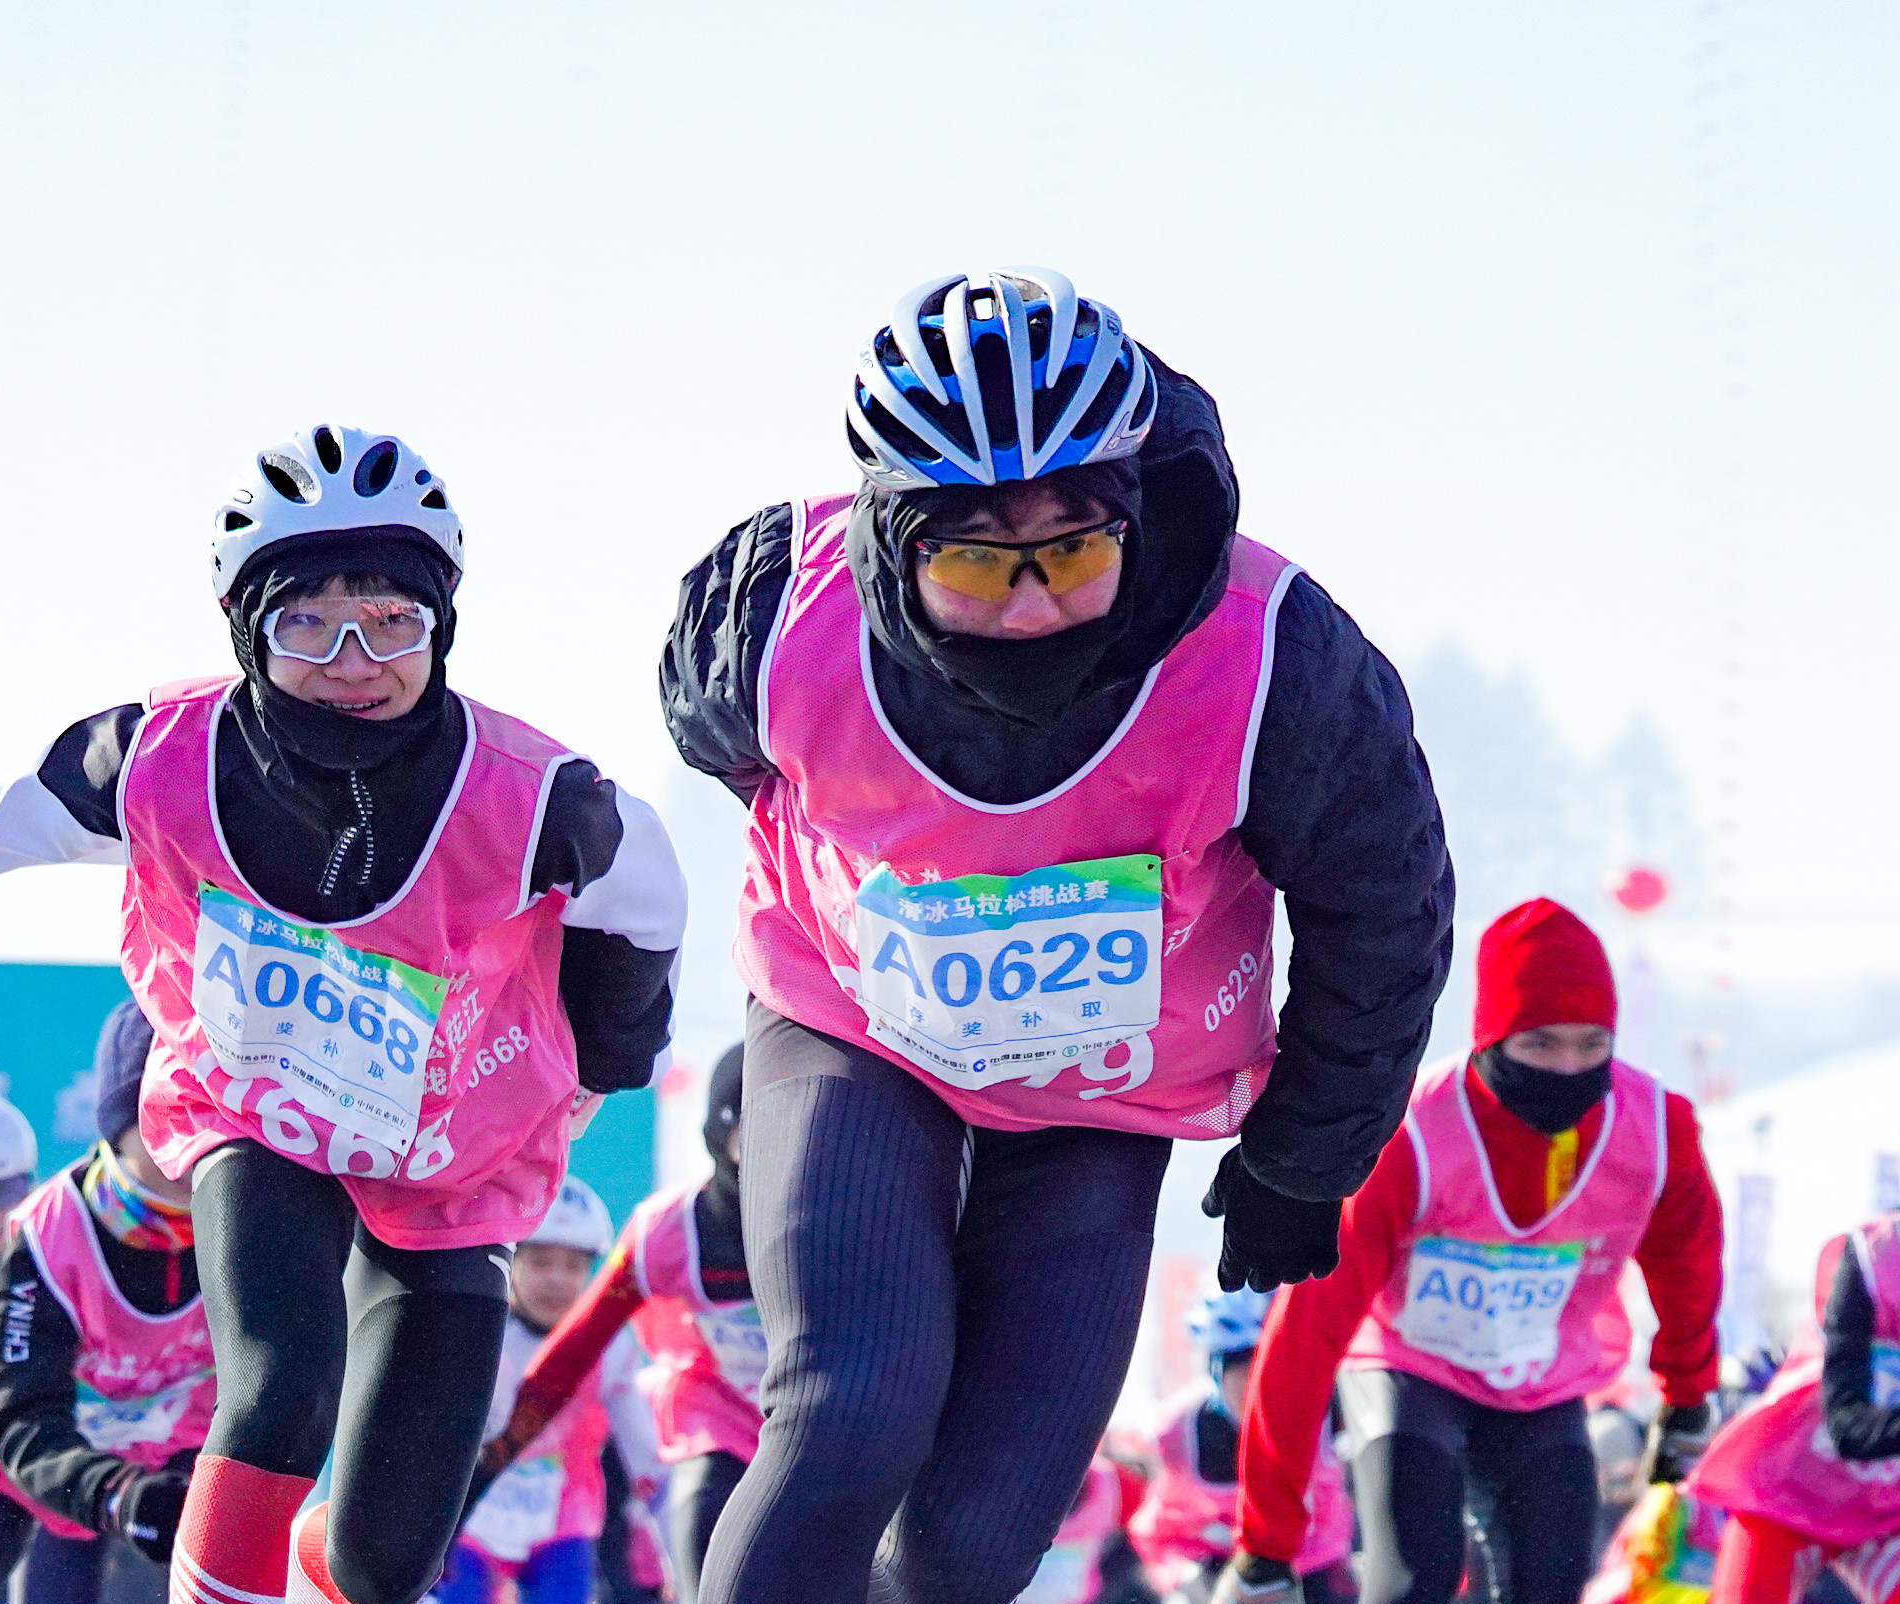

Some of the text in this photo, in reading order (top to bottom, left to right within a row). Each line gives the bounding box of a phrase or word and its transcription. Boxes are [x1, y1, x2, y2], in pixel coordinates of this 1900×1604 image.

[898, 879, 1110, 924] 滑冰马拉松挑战赛
[202, 941, 419, 1075] A0668
[870, 928, 1150, 1008] A0629
[1203, 951, 1259, 1032] 0629
[961, 1020, 983, 1038] 奖
[1020, 1010, 1043, 1029] 补
[1080, 1001, 1102, 1018] 取
[367, 1060, 385, 1081] 取
[194, 1050, 456, 1181] 668
[4, 1279, 39, 1364] CHINA
